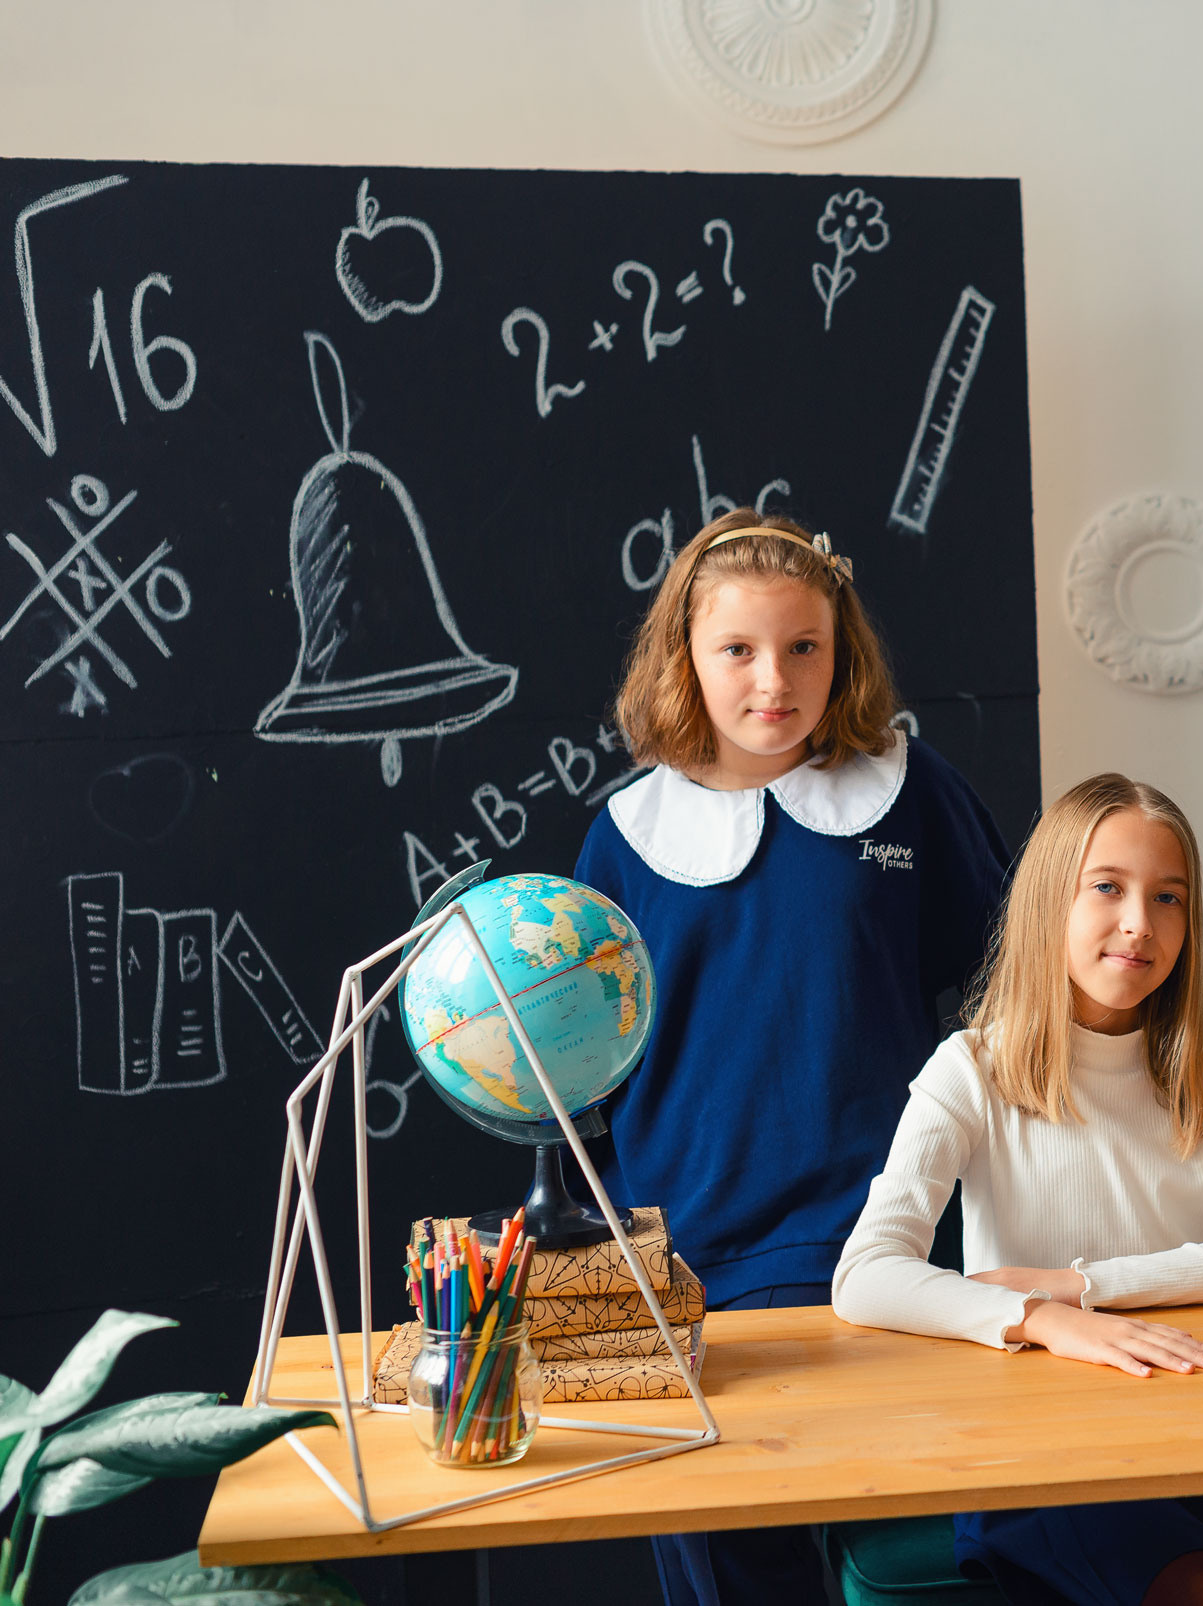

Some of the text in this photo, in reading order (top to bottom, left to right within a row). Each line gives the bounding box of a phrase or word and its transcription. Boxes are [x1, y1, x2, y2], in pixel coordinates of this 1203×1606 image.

[858, 838, 914, 871] Inspire
[887, 859, 914, 871] OTHERS
[178, 935, 202, 983] B
[237, 950, 263, 982] C
